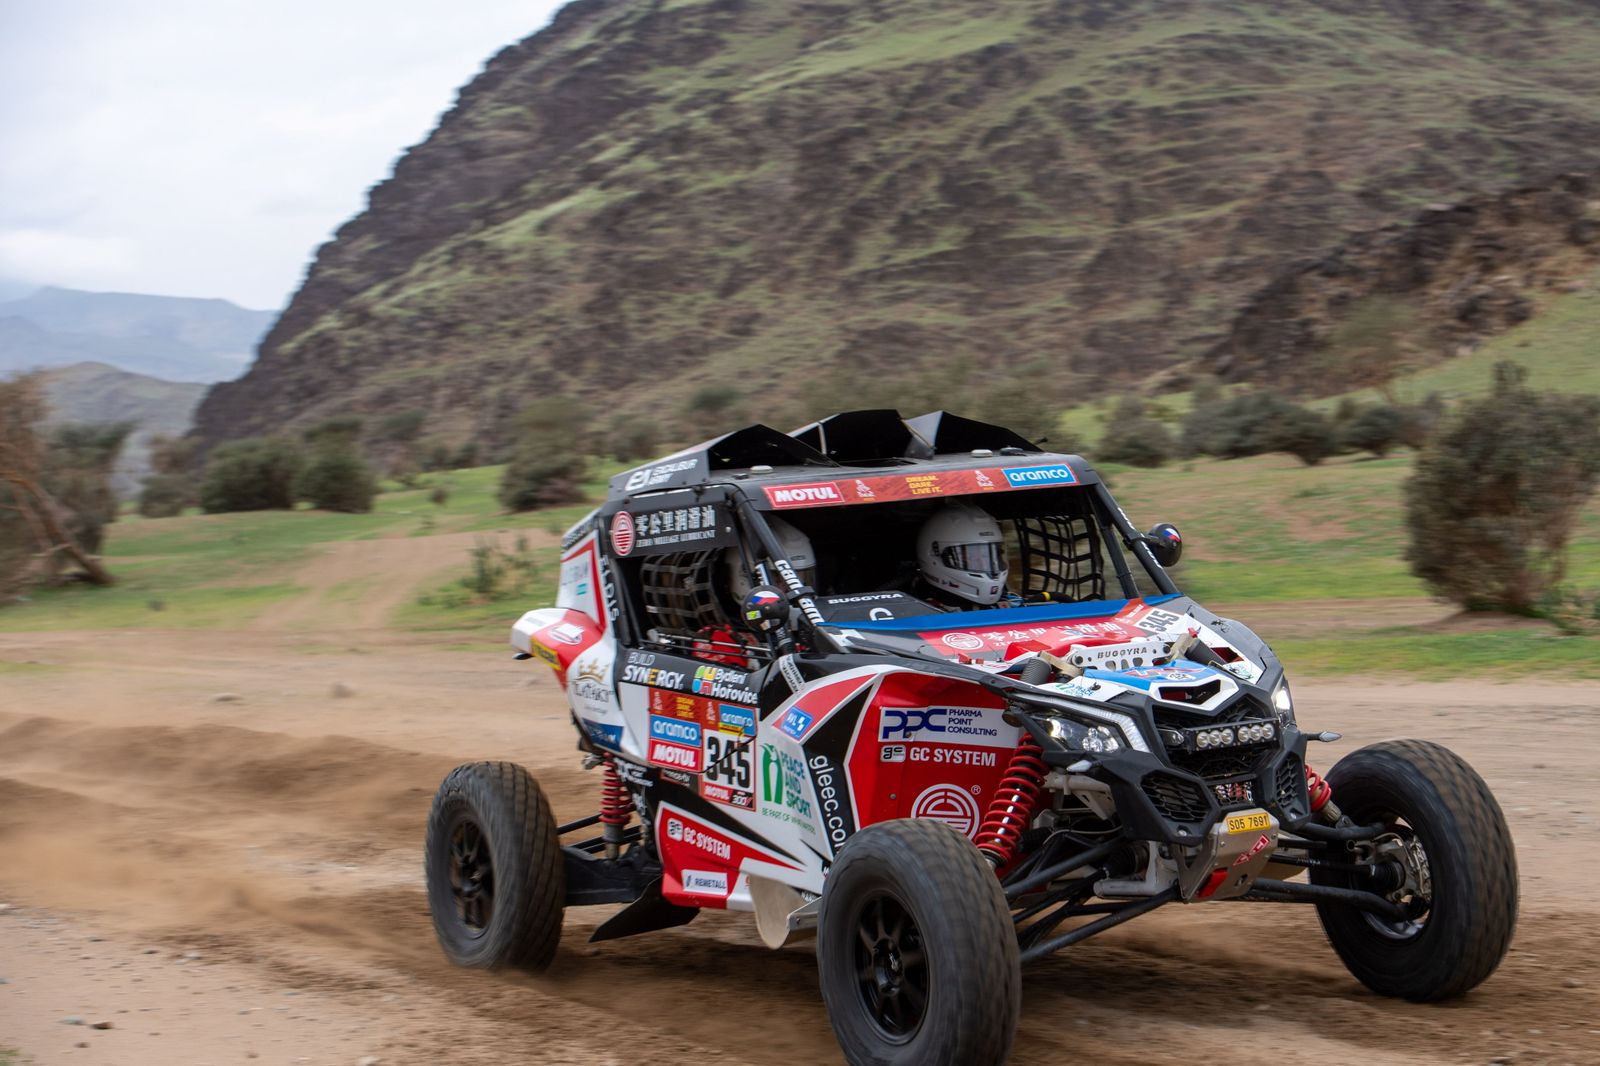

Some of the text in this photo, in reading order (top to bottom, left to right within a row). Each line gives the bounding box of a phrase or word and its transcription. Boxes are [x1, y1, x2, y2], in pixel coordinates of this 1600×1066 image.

[1010, 468, 1069, 481] aramco
[774, 487, 839, 502] MOTUL
[828, 593, 904, 604] BUGGYRA
[1138, 610, 1180, 632] 345
[1097, 647, 1148, 659] BUGGYRA
[622, 664, 686, 690] SYNERGY
[711, 683, 759, 704] Hořovice
[722, 712, 754, 727] aramco
[948, 709, 983, 718] PHARMA
[948, 717, 973, 726] POINT
[653, 720, 698, 741] aramco
[947, 726, 998, 737] CONSULTING
[653, 744, 697, 767] MOTUL
[705, 736, 751, 788] 345
[910, 747, 997, 767] GC SYSTEM
[704, 785, 731, 801] MOTUL
[786, 790, 812, 819] SPORT
[1248, 815, 1269, 829] 7691
[683, 826, 731, 861] GC SYSTEM
